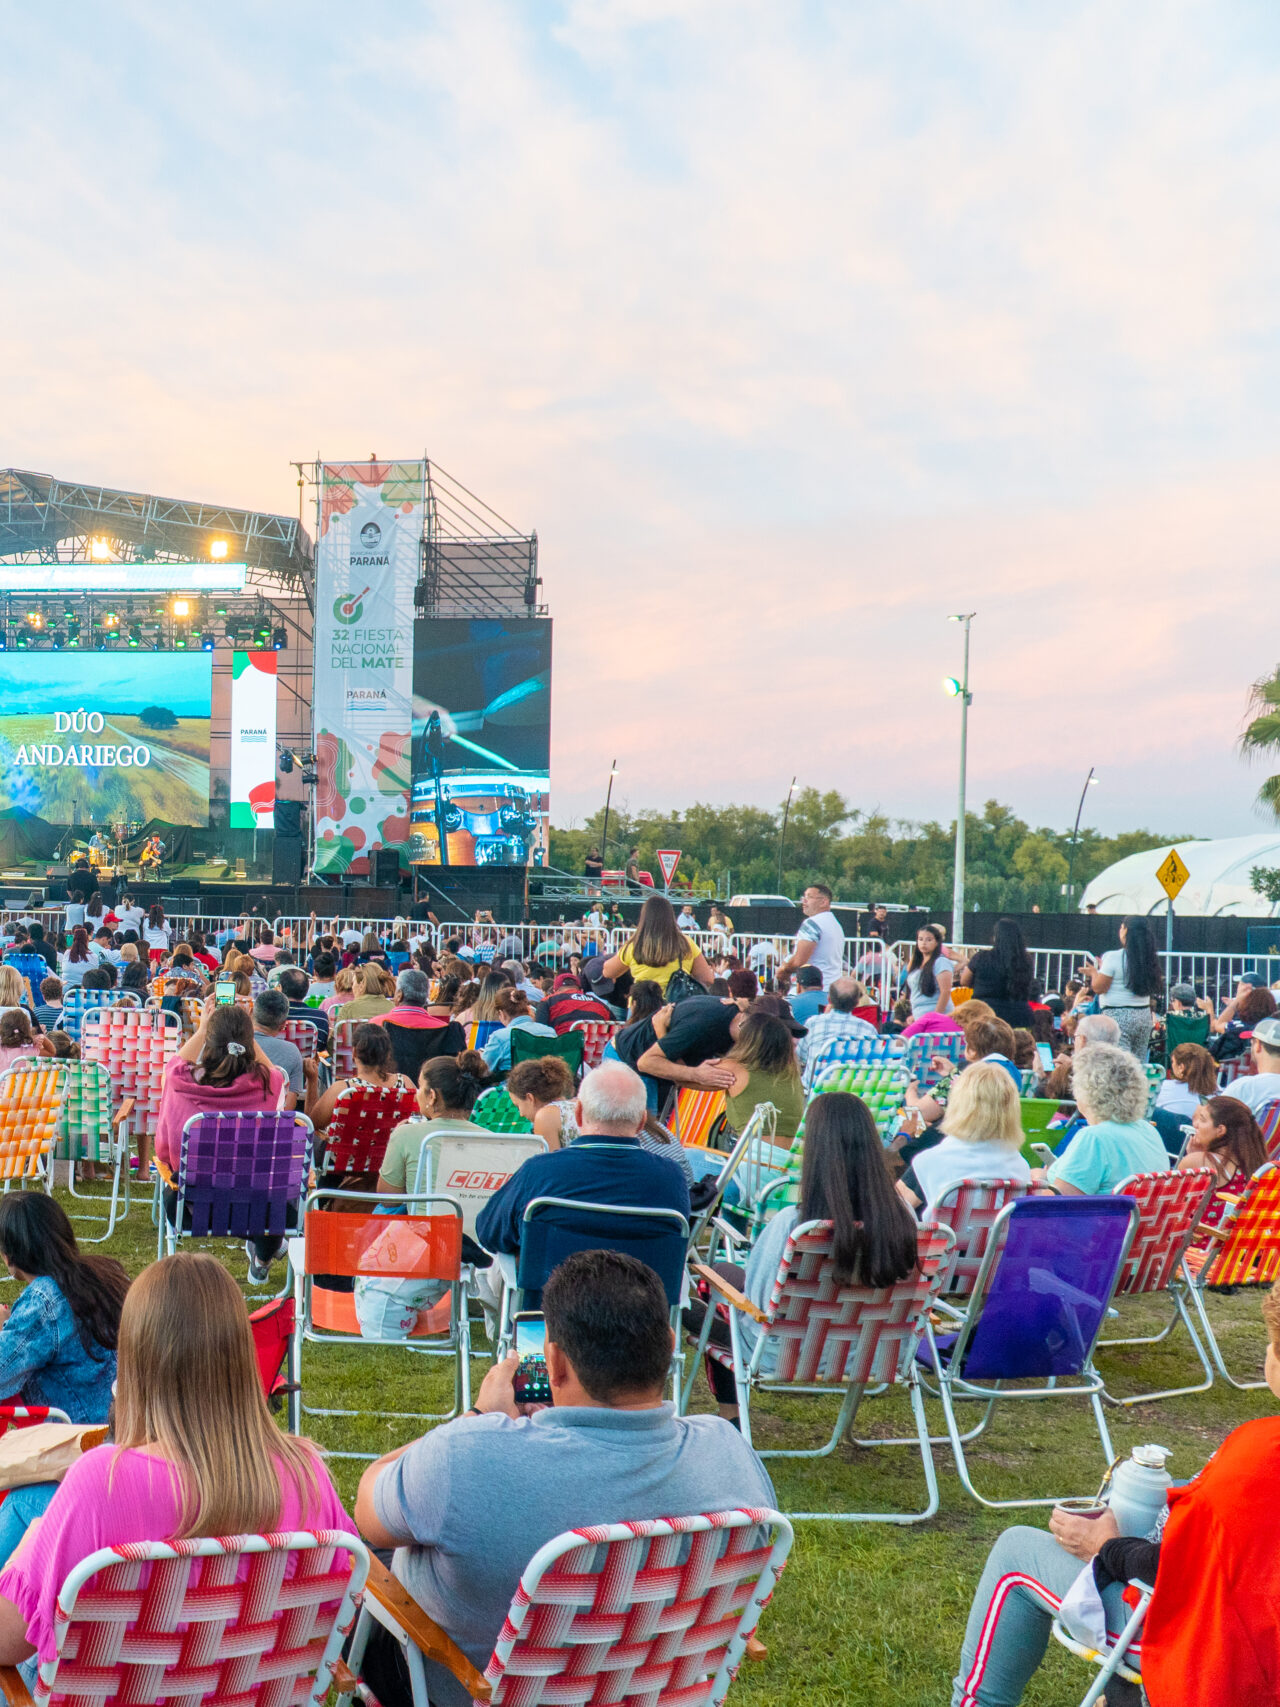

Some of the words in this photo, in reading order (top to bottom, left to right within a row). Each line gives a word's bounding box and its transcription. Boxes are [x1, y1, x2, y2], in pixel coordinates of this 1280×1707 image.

[350, 555, 389, 566] PARANÁ
[332, 629, 349, 640] 32
[354, 629, 404, 640] FIESTA
[331, 643, 404, 654] NACIONAL
[331, 657, 358, 668] DEL
[362, 657, 404, 668] MATE
[346, 689, 387, 699] PARANÁ
[54, 707, 105, 733] DÚO
[13, 744, 151, 767] ANDARIEGO
